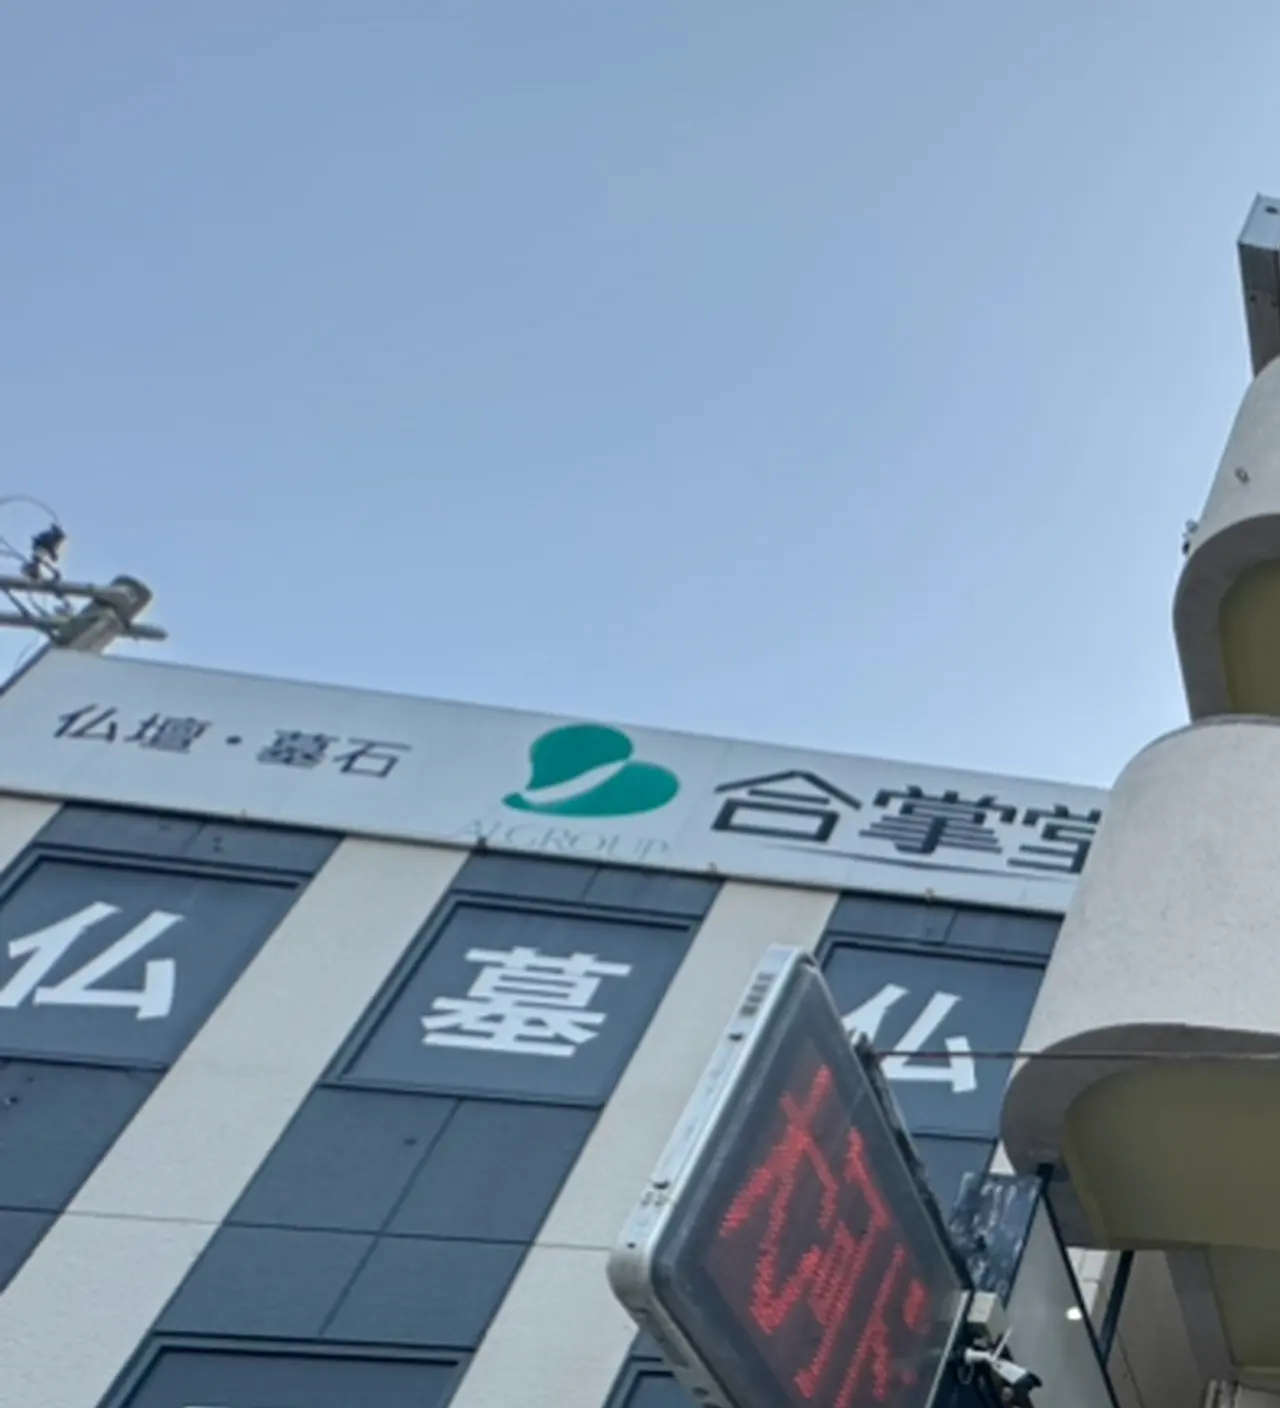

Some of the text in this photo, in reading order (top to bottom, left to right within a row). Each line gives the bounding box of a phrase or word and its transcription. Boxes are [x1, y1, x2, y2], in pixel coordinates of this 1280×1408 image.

[52, 702, 413, 779] 仏壇・墓石
[710, 769, 1102, 874] 合掌堂
[0, 902, 184, 1020] 仏
[420, 946, 633, 1057] 墓
[843, 984, 979, 1093] 仏
